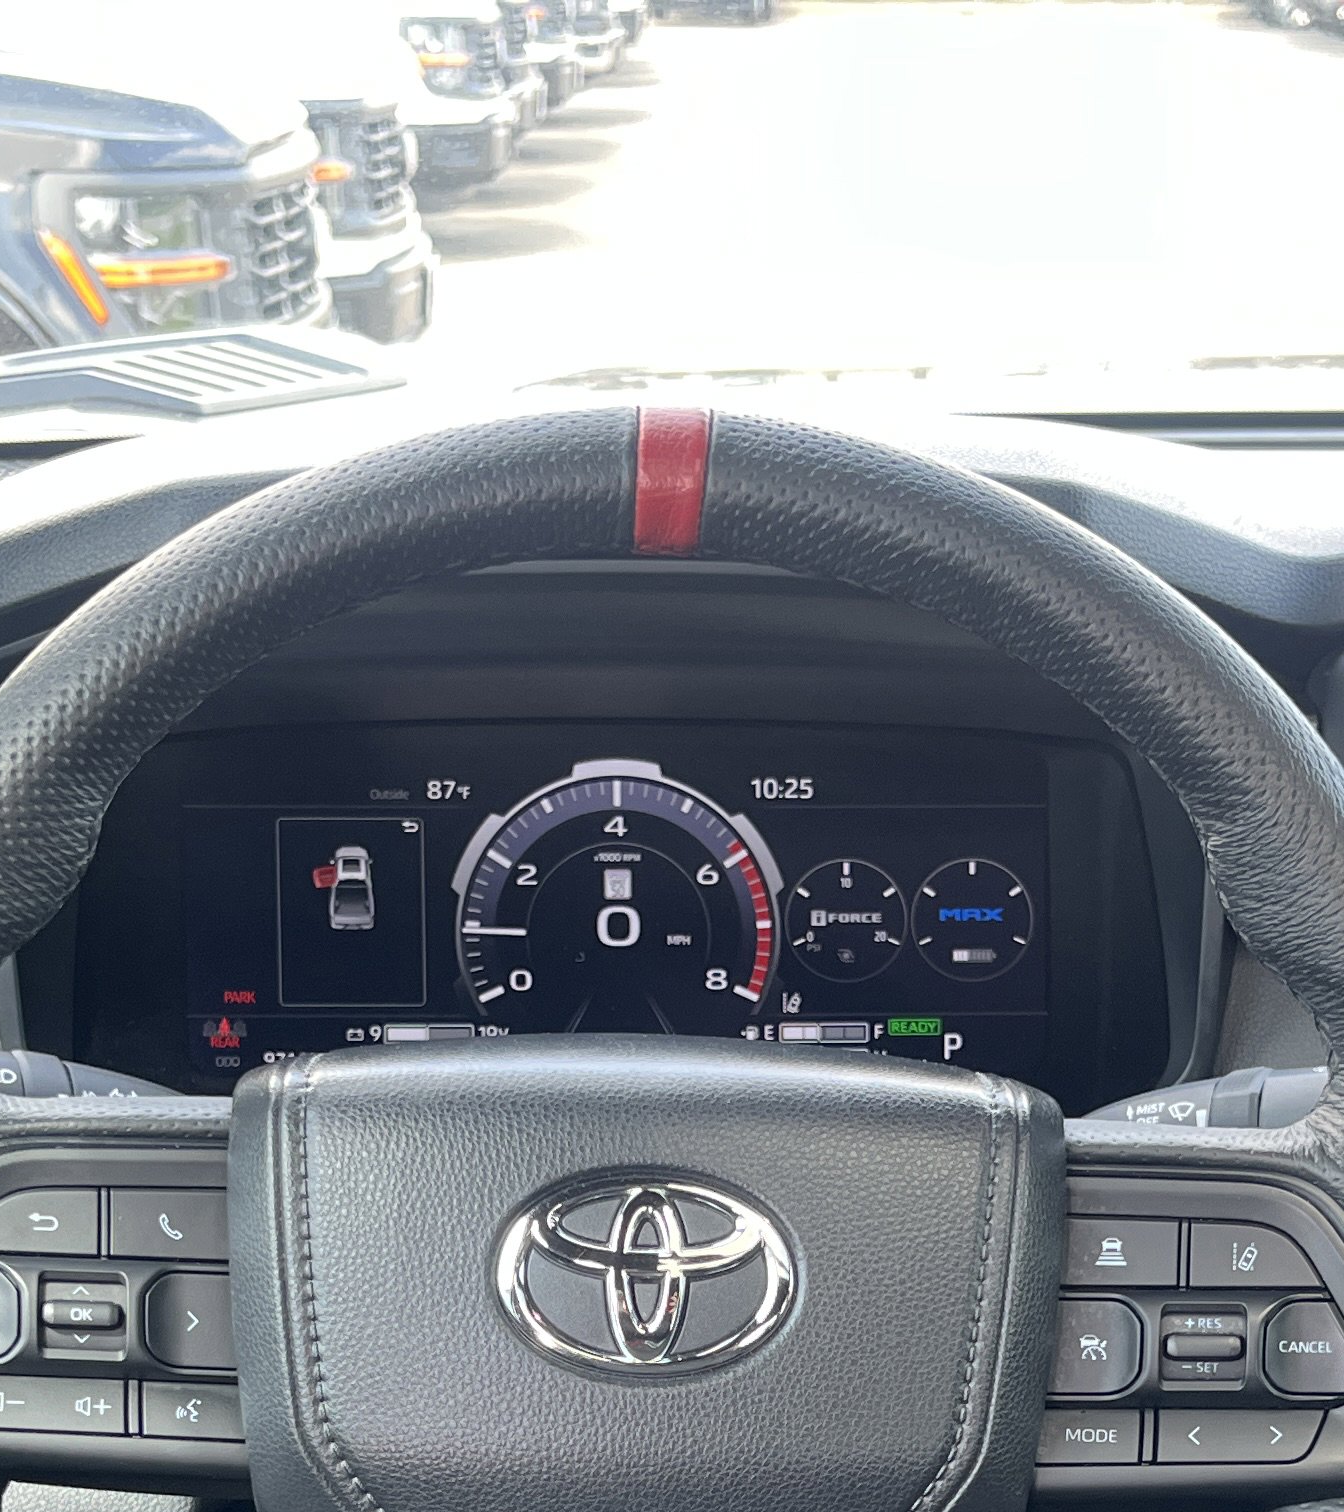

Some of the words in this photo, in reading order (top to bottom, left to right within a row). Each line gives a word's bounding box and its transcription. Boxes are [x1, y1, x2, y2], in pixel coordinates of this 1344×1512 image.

[370, 788, 410, 801] Outside
[751, 778, 815, 799] 10:25
[603, 815, 629, 837] 4
[516, 863, 539, 886] 2
[696, 863, 720, 886] 6
[840, 877, 854, 889] 10
[828, 912, 883, 923] FORCE
[938, 907, 1004, 923] MAX
[596, 904, 642, 948] 0
[666, 935, 692, 947] MPH
[806, 930, 815, 942] 0
[873, 930, 887, 942] 20
[509, 969, 533, 992] 0
[705, 968, 729, 992] 8
[223, 990, 257, 1004] PARK
[369, 1025, 382, 1042] 9
[764, 1024, 774, 1041] E
[873, 1024, 884, 1039] F
[891, 1020, 938, 1033] READY
[210, 1036, 241, 1049] REAR
[943, 1032, 963, 1060] P
[1135, 1102, 1166, 1116] MIST
[69, 1307, 94, 1323] OK
[1278, 1339, 1333, 1354] CANCEL
[1195, 1361, 1220, 1374] SET
[1065, 1428, 1118, 1444] MODE
